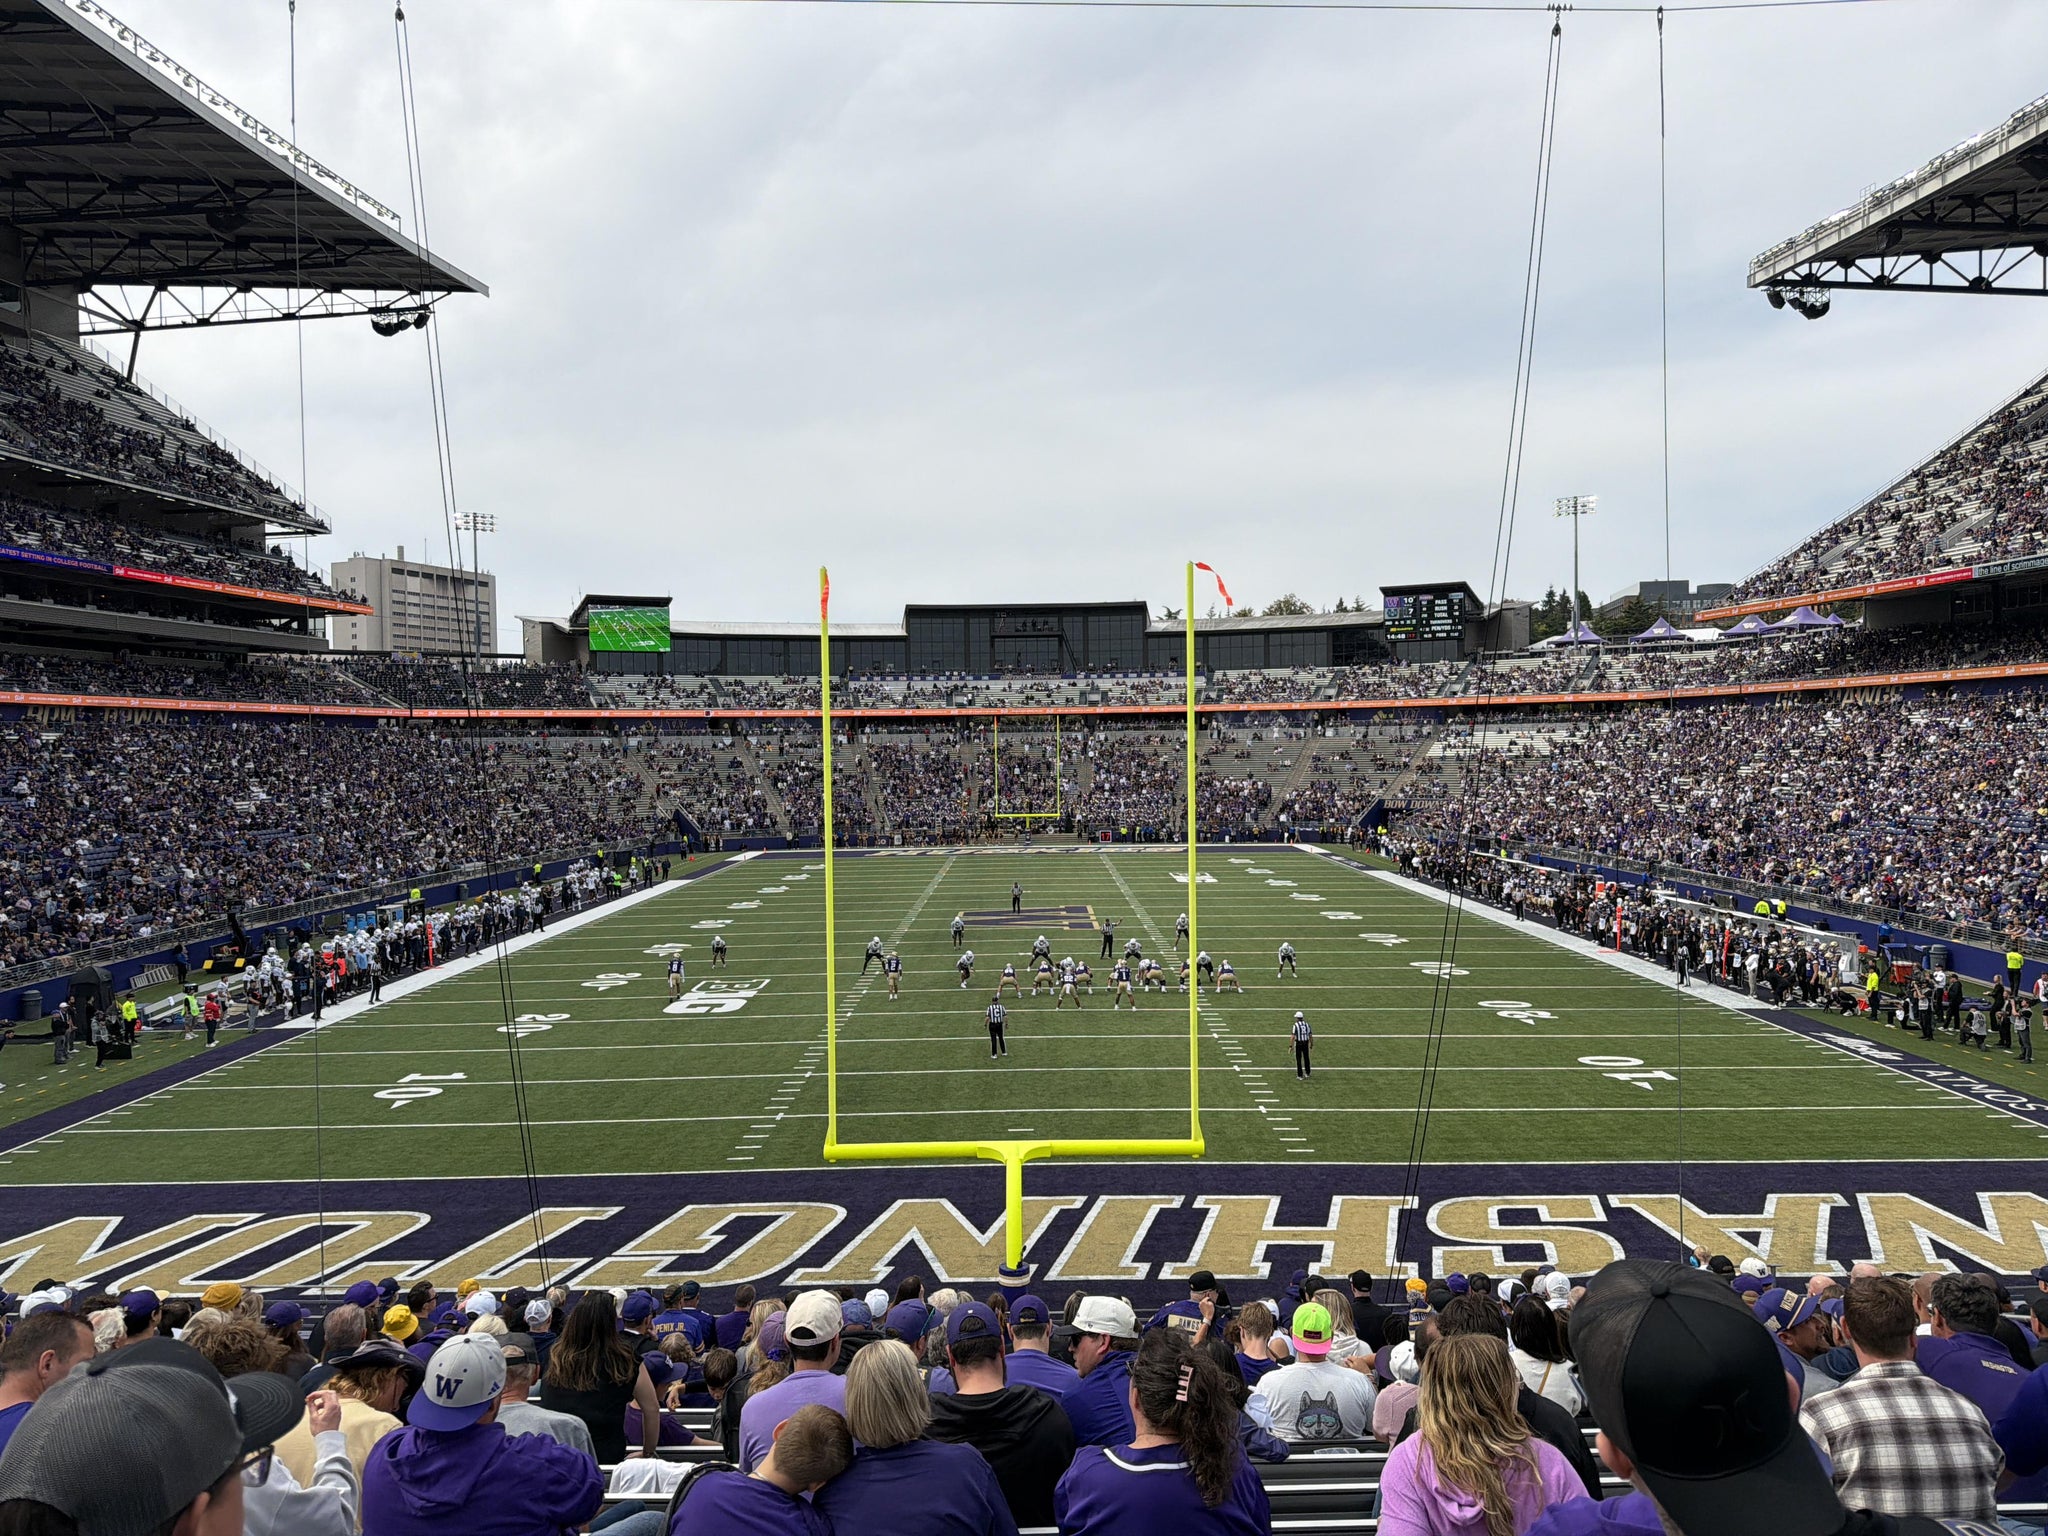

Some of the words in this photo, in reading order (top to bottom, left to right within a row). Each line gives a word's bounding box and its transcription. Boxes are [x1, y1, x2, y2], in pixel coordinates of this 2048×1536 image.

[21, 552, 45, 560] SETTING
[53, 558, 78, 566] COLLEGE
[80, 562, 108, 571] FOOTBALL
[1990, 564, 2002, 573] line
[2003, 562, 2010, 571] of
[1384, 800, 1407, 808] BOW
[1101, 832, 1110, 841] 17
[1478, 1000, 1560, 1019] 20
[496, 1014, 572, 1035] 20
[1577, 1056, 1678, 1081] 10
[373, 1072, 468, 1100] 10
[1757, 1268, 1766, 1276] W
[656, 1323, 675, 1332] PENIX
[676, 1322, 686, 1332] JR.
[436, 1374, 463, 1400] W
